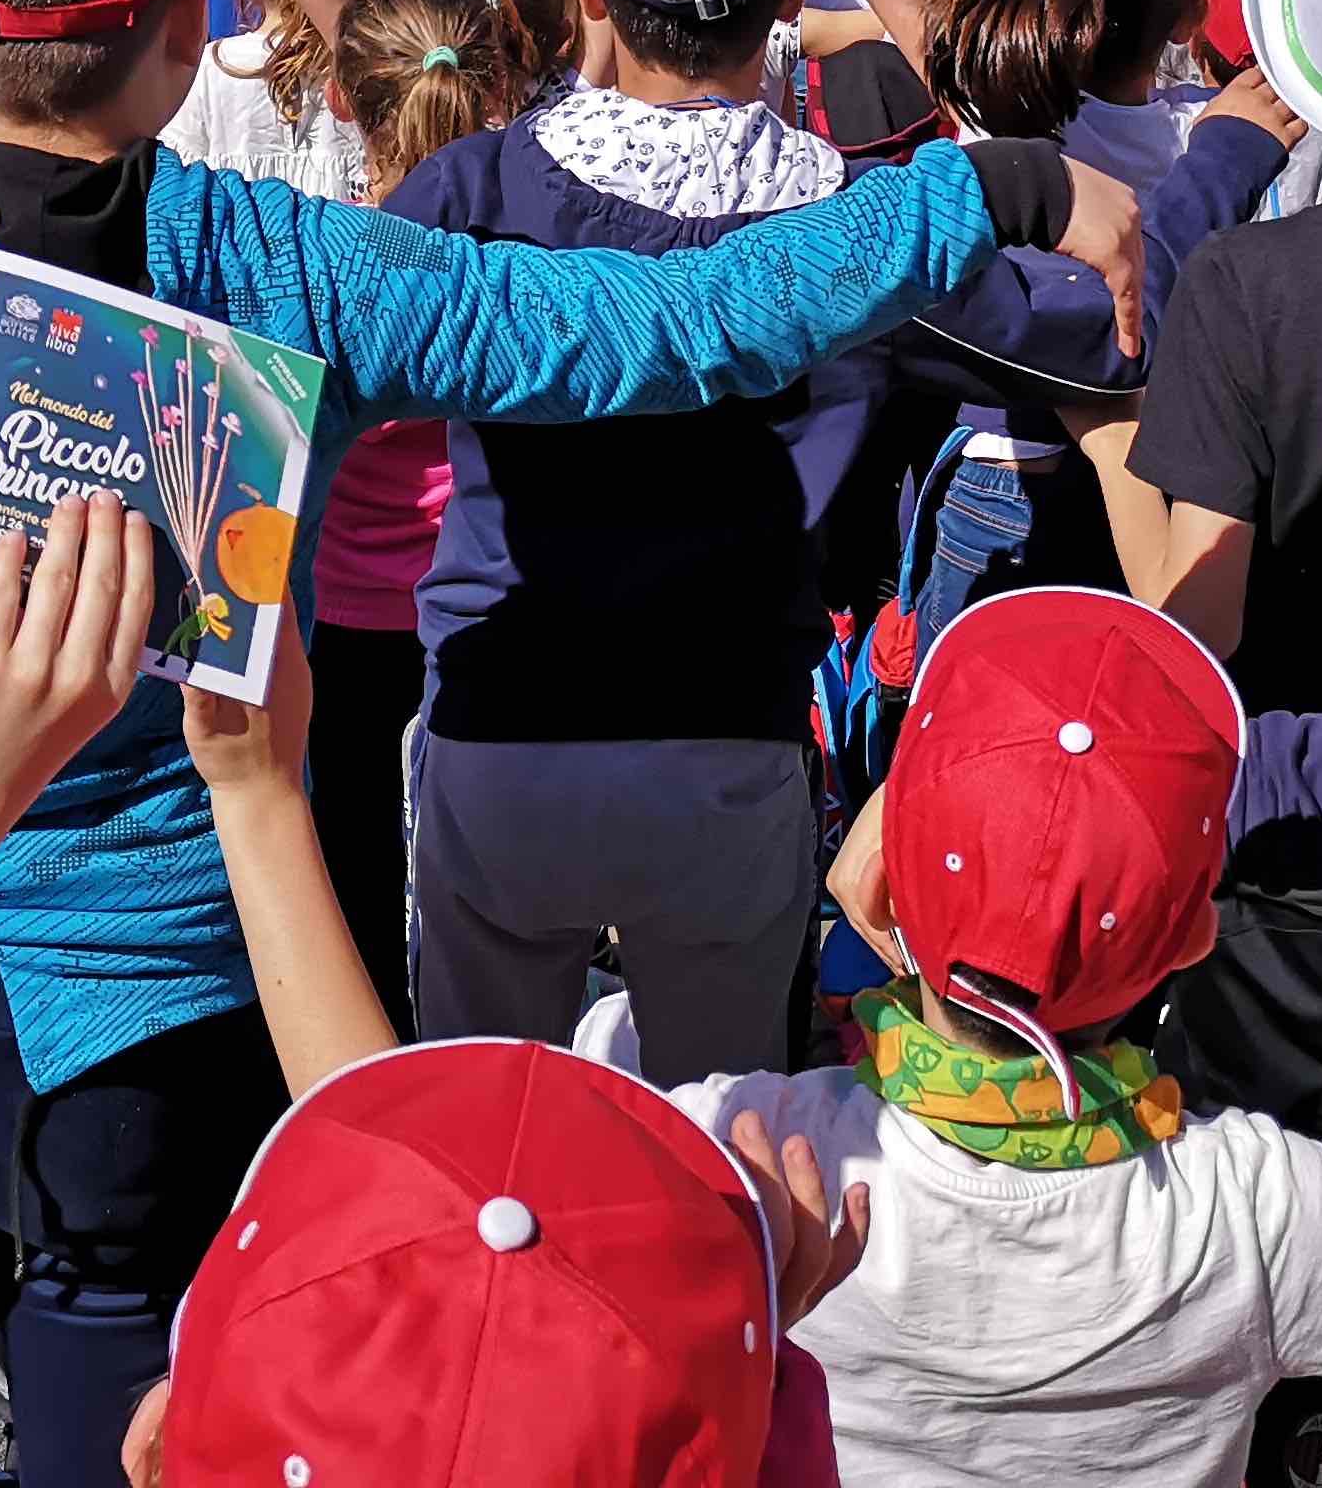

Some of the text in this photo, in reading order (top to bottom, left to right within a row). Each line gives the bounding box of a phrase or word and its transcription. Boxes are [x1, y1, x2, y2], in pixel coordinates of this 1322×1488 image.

[45, 335, 77, 355] libro
[9, 380, 115, 431] Nel mondo del
[0, 410, 146, 483] Piccolo
